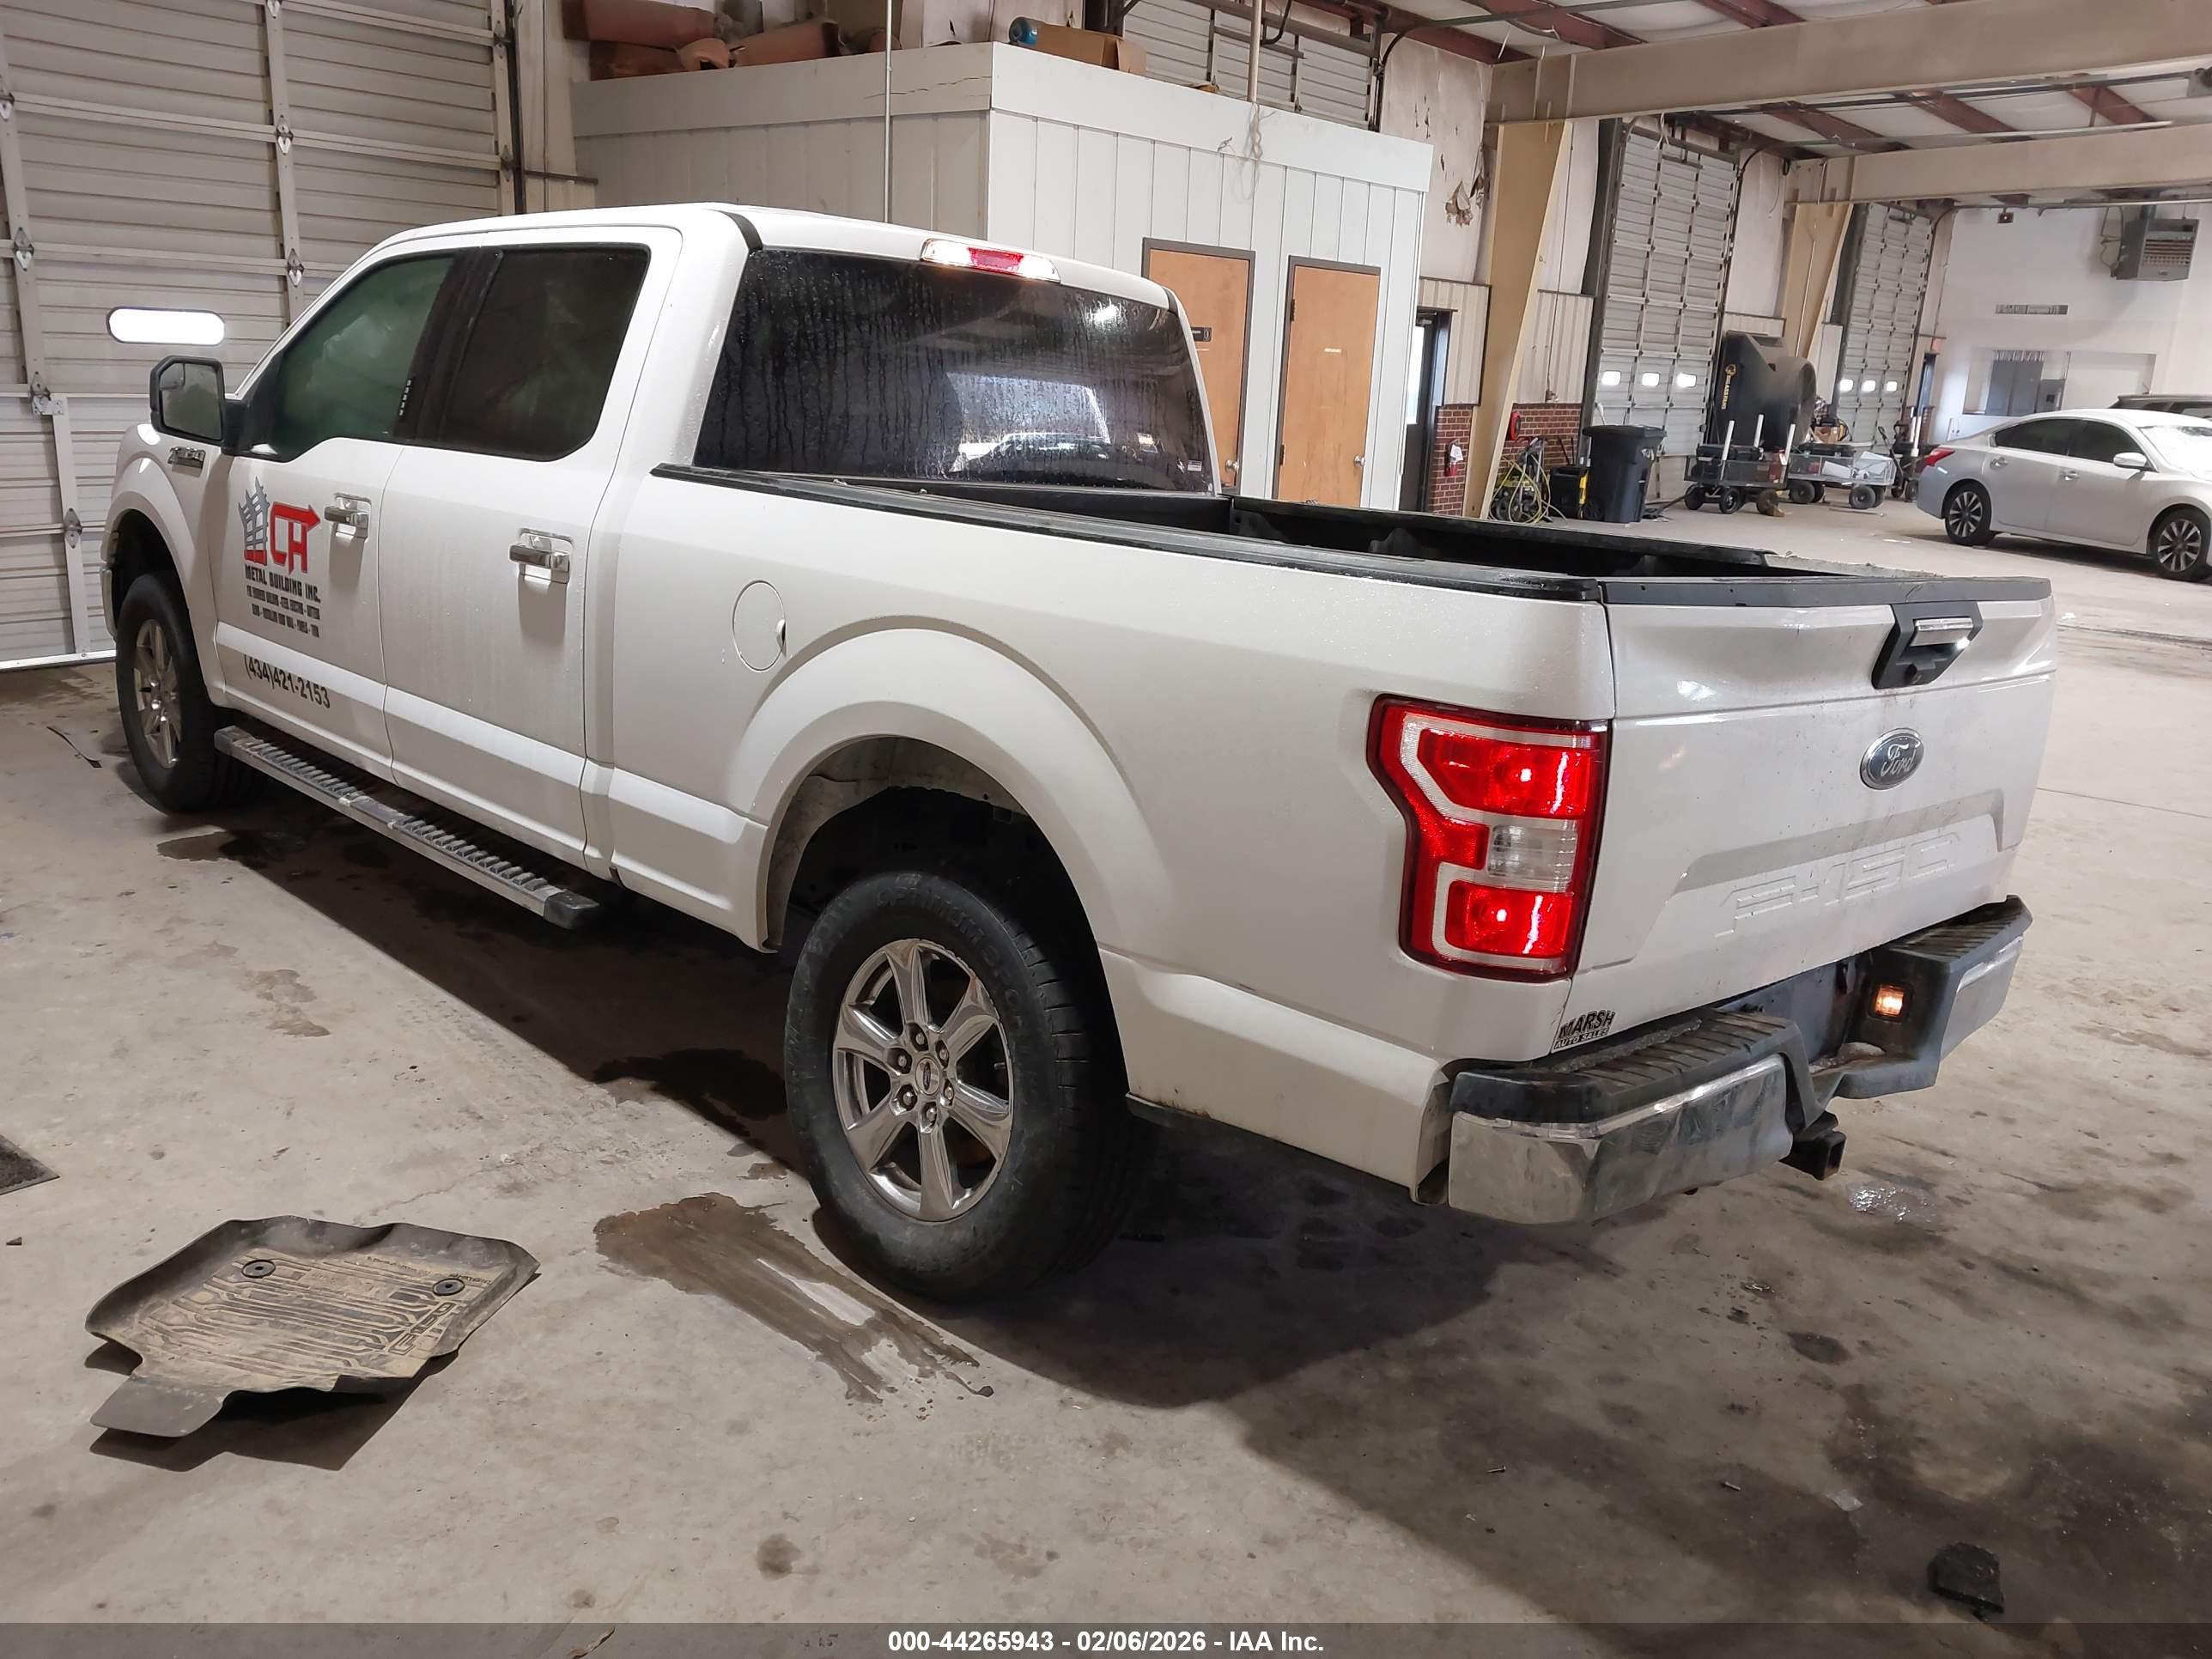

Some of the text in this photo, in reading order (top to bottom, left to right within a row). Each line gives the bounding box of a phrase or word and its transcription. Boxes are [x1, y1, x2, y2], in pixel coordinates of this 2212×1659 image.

[245, 563, 267, 586] METAL
[269, 571, 302, 597] BUILDING
[305, 583, 321, 603] INC.
[1881, 743, 1917, 777] Ford
[1715, 832, 1960, 938] F-150
[1559, 1009, 1616, 1039] MARSH
[1554, 1035, 1581, 1049] AUTO
